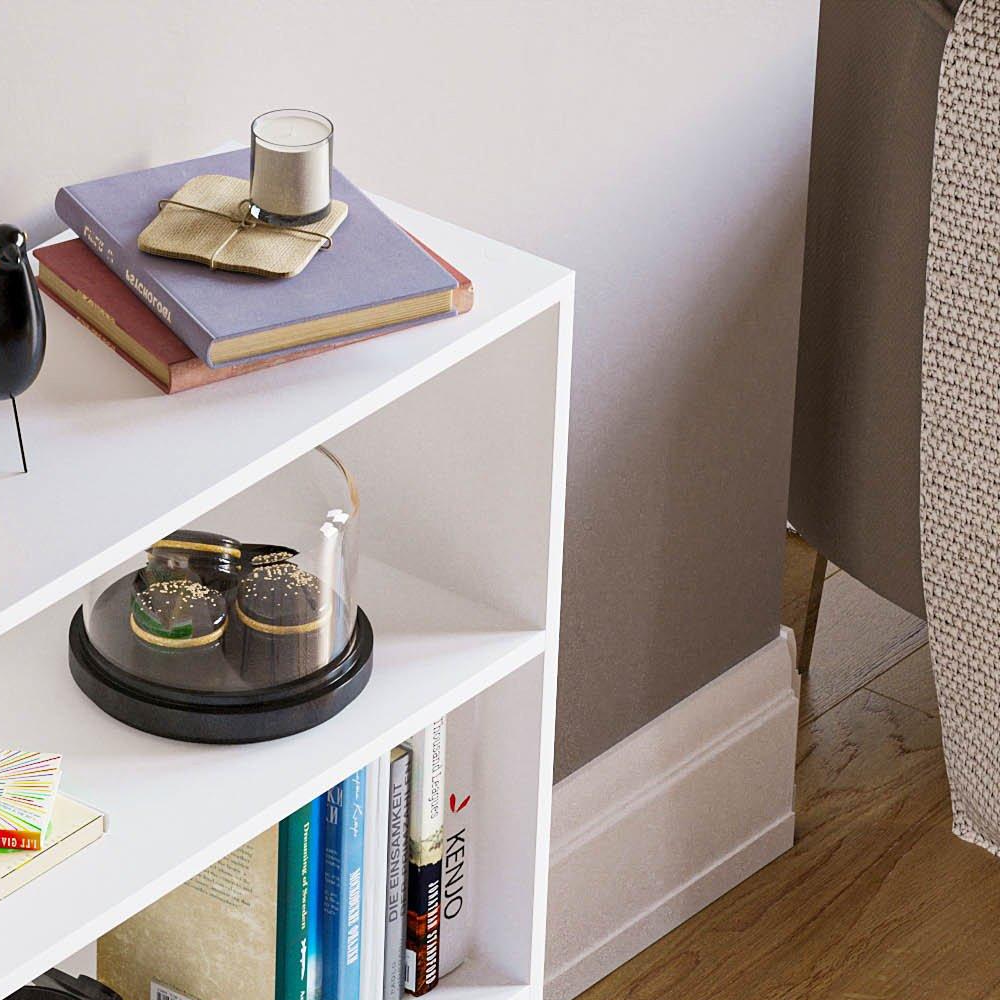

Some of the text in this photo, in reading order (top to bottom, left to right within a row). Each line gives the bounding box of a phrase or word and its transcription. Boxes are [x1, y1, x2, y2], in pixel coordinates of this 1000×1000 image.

[389, 783, 402, 922] DIE EINSAMKEIT
[444, 828, 465, 920] KENJO
